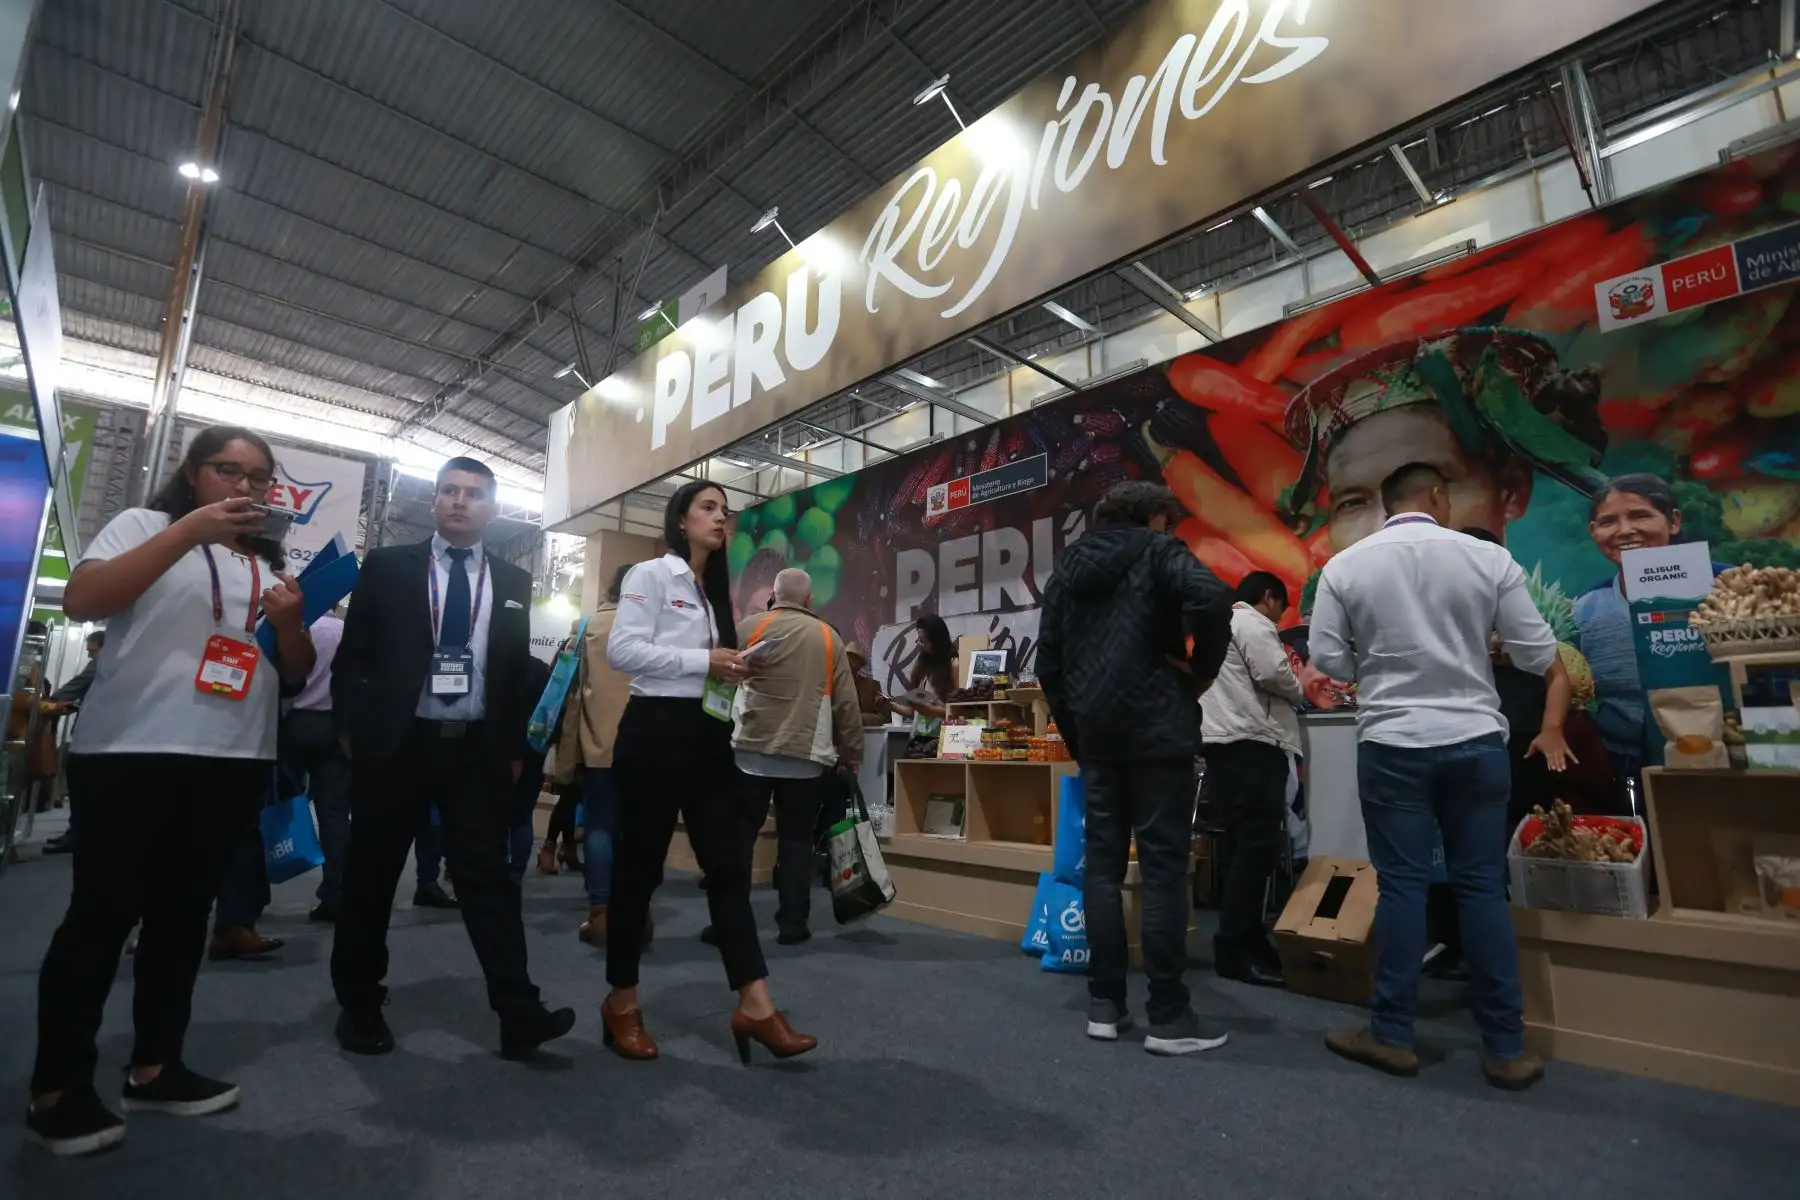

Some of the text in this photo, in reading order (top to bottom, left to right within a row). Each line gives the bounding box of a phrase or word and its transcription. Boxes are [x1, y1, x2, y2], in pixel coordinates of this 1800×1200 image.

[858, 0, 1329, 318] Regiones
[1673, 263, 1727, 293] PERÚ
[1749, 266, 1771, 281] de
[972, 479, 1001, 492] Ministerio
[972, 492, 980, 500] de
[981, 482, 1011, 498] Agricultura
[1017, 477, 1035, 487] Riego
[949, 486, 967, 500] PERÚ
[1643, 564, 1681, 575] ELISUR
[1639, 572, 1688, 583] ORGANIC
